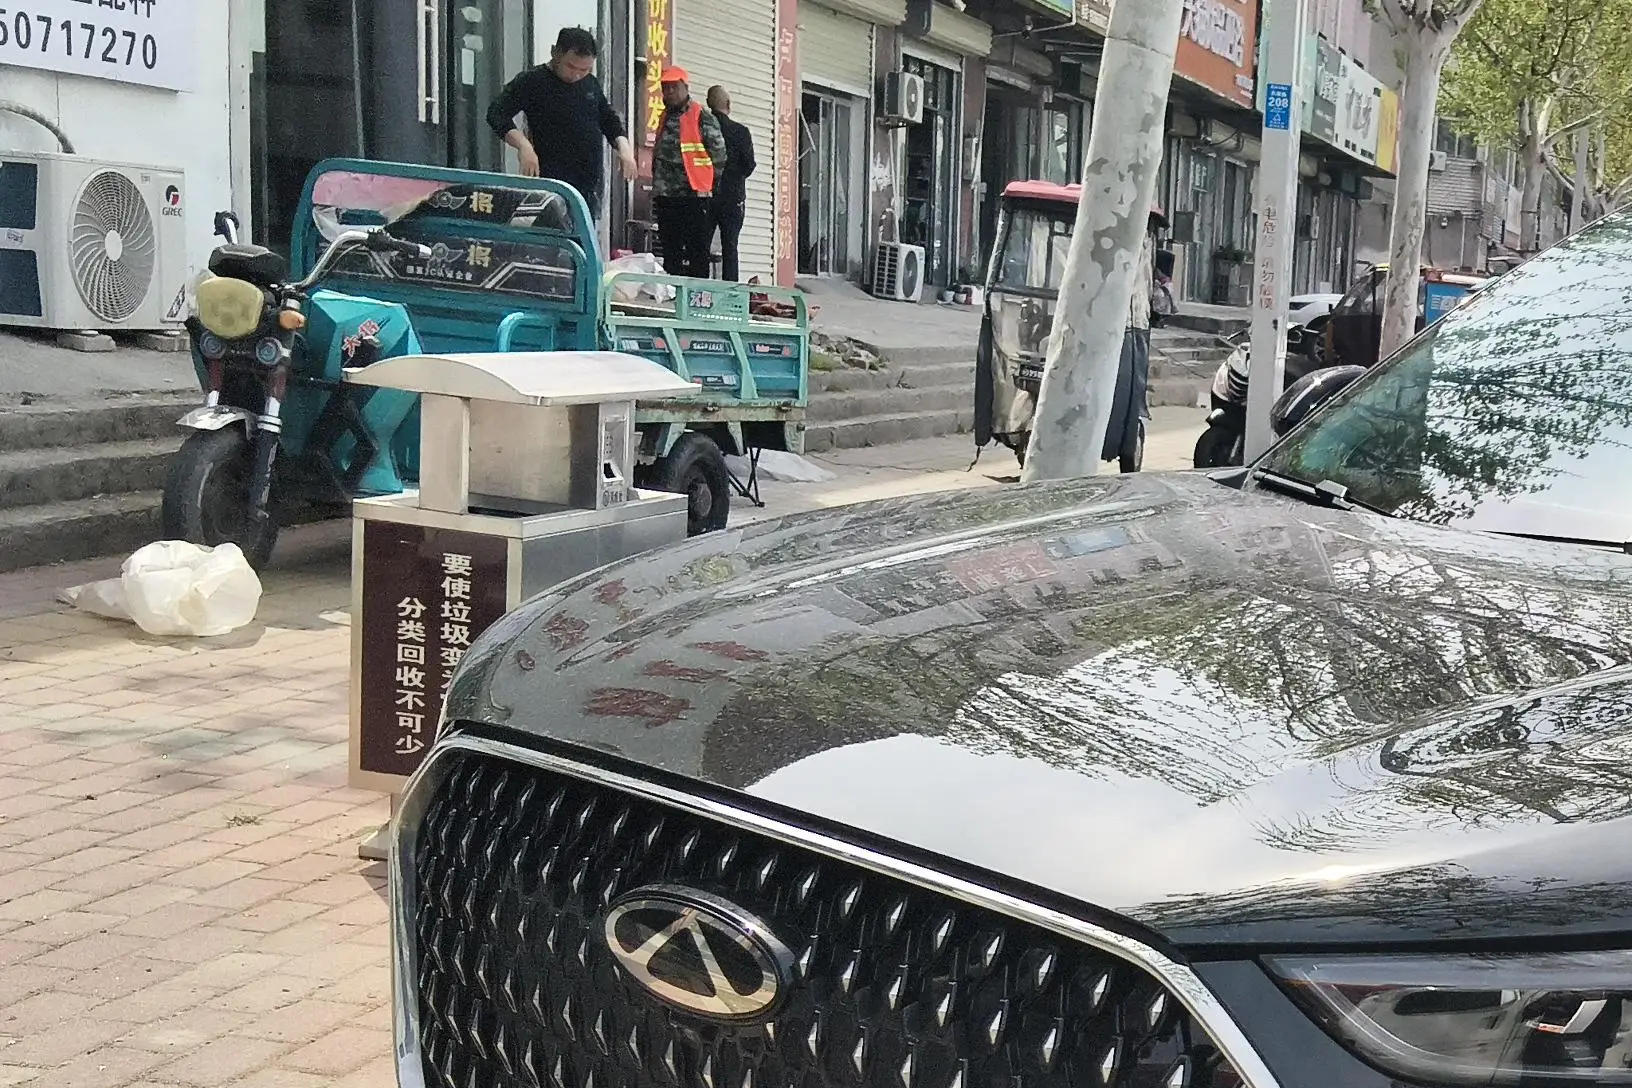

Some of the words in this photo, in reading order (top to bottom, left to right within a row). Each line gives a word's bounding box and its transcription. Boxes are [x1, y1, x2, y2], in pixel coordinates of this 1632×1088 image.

[1268, 97, 1289, 108] 208
[395, 596, 427, 754] 分类回收不可少
